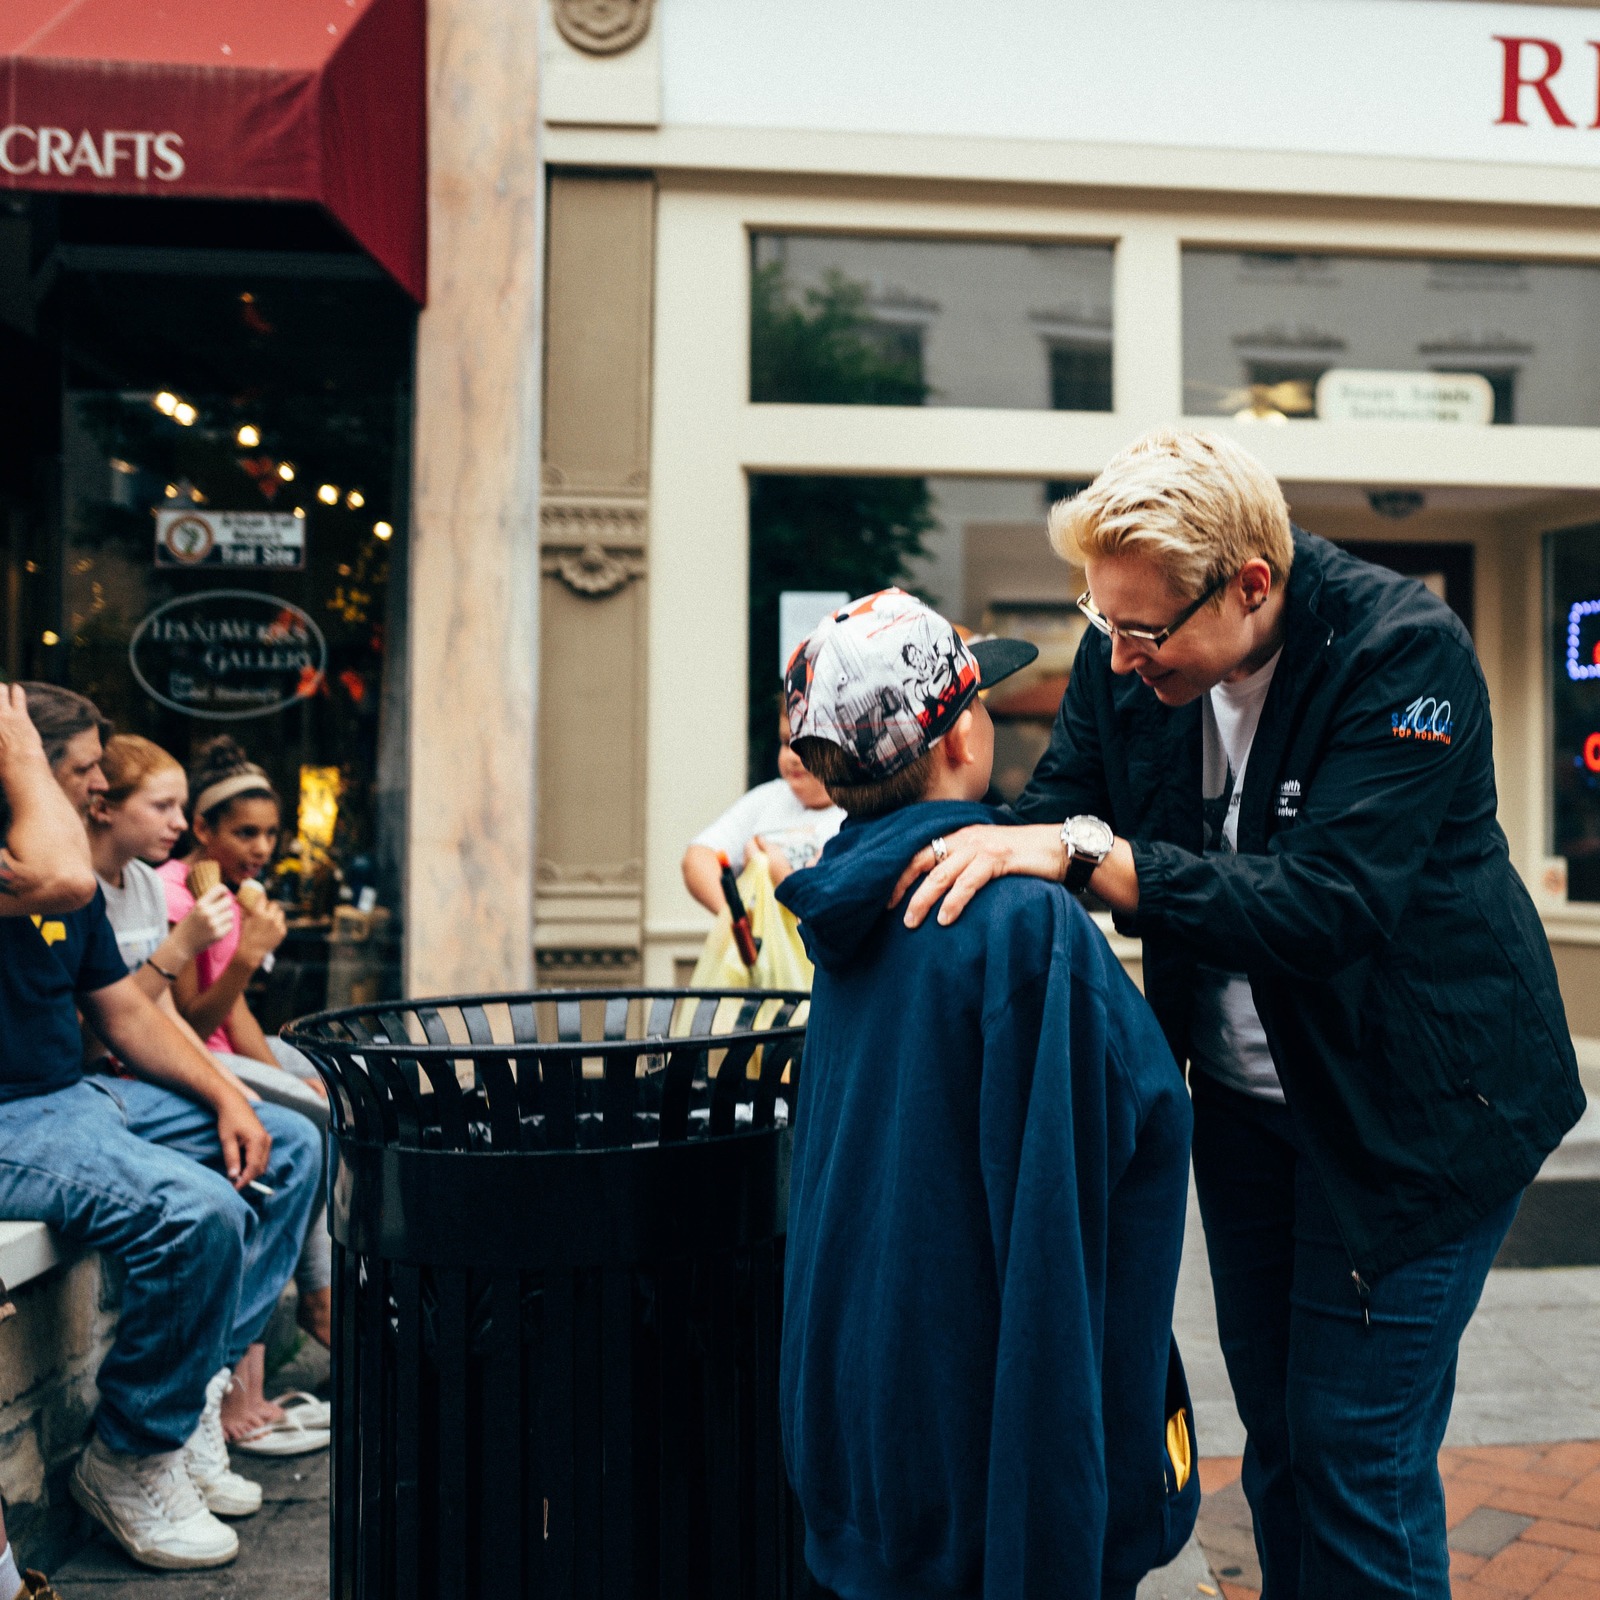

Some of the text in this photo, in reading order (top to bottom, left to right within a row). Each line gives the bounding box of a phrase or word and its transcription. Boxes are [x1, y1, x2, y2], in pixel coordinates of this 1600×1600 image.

[1491, 34, 1600, 131] R
[0, 124, 186, 182] CRAFTS
[1392, 726, 1412, 739] TOP
[1399, 695, 1451, 735] 100
